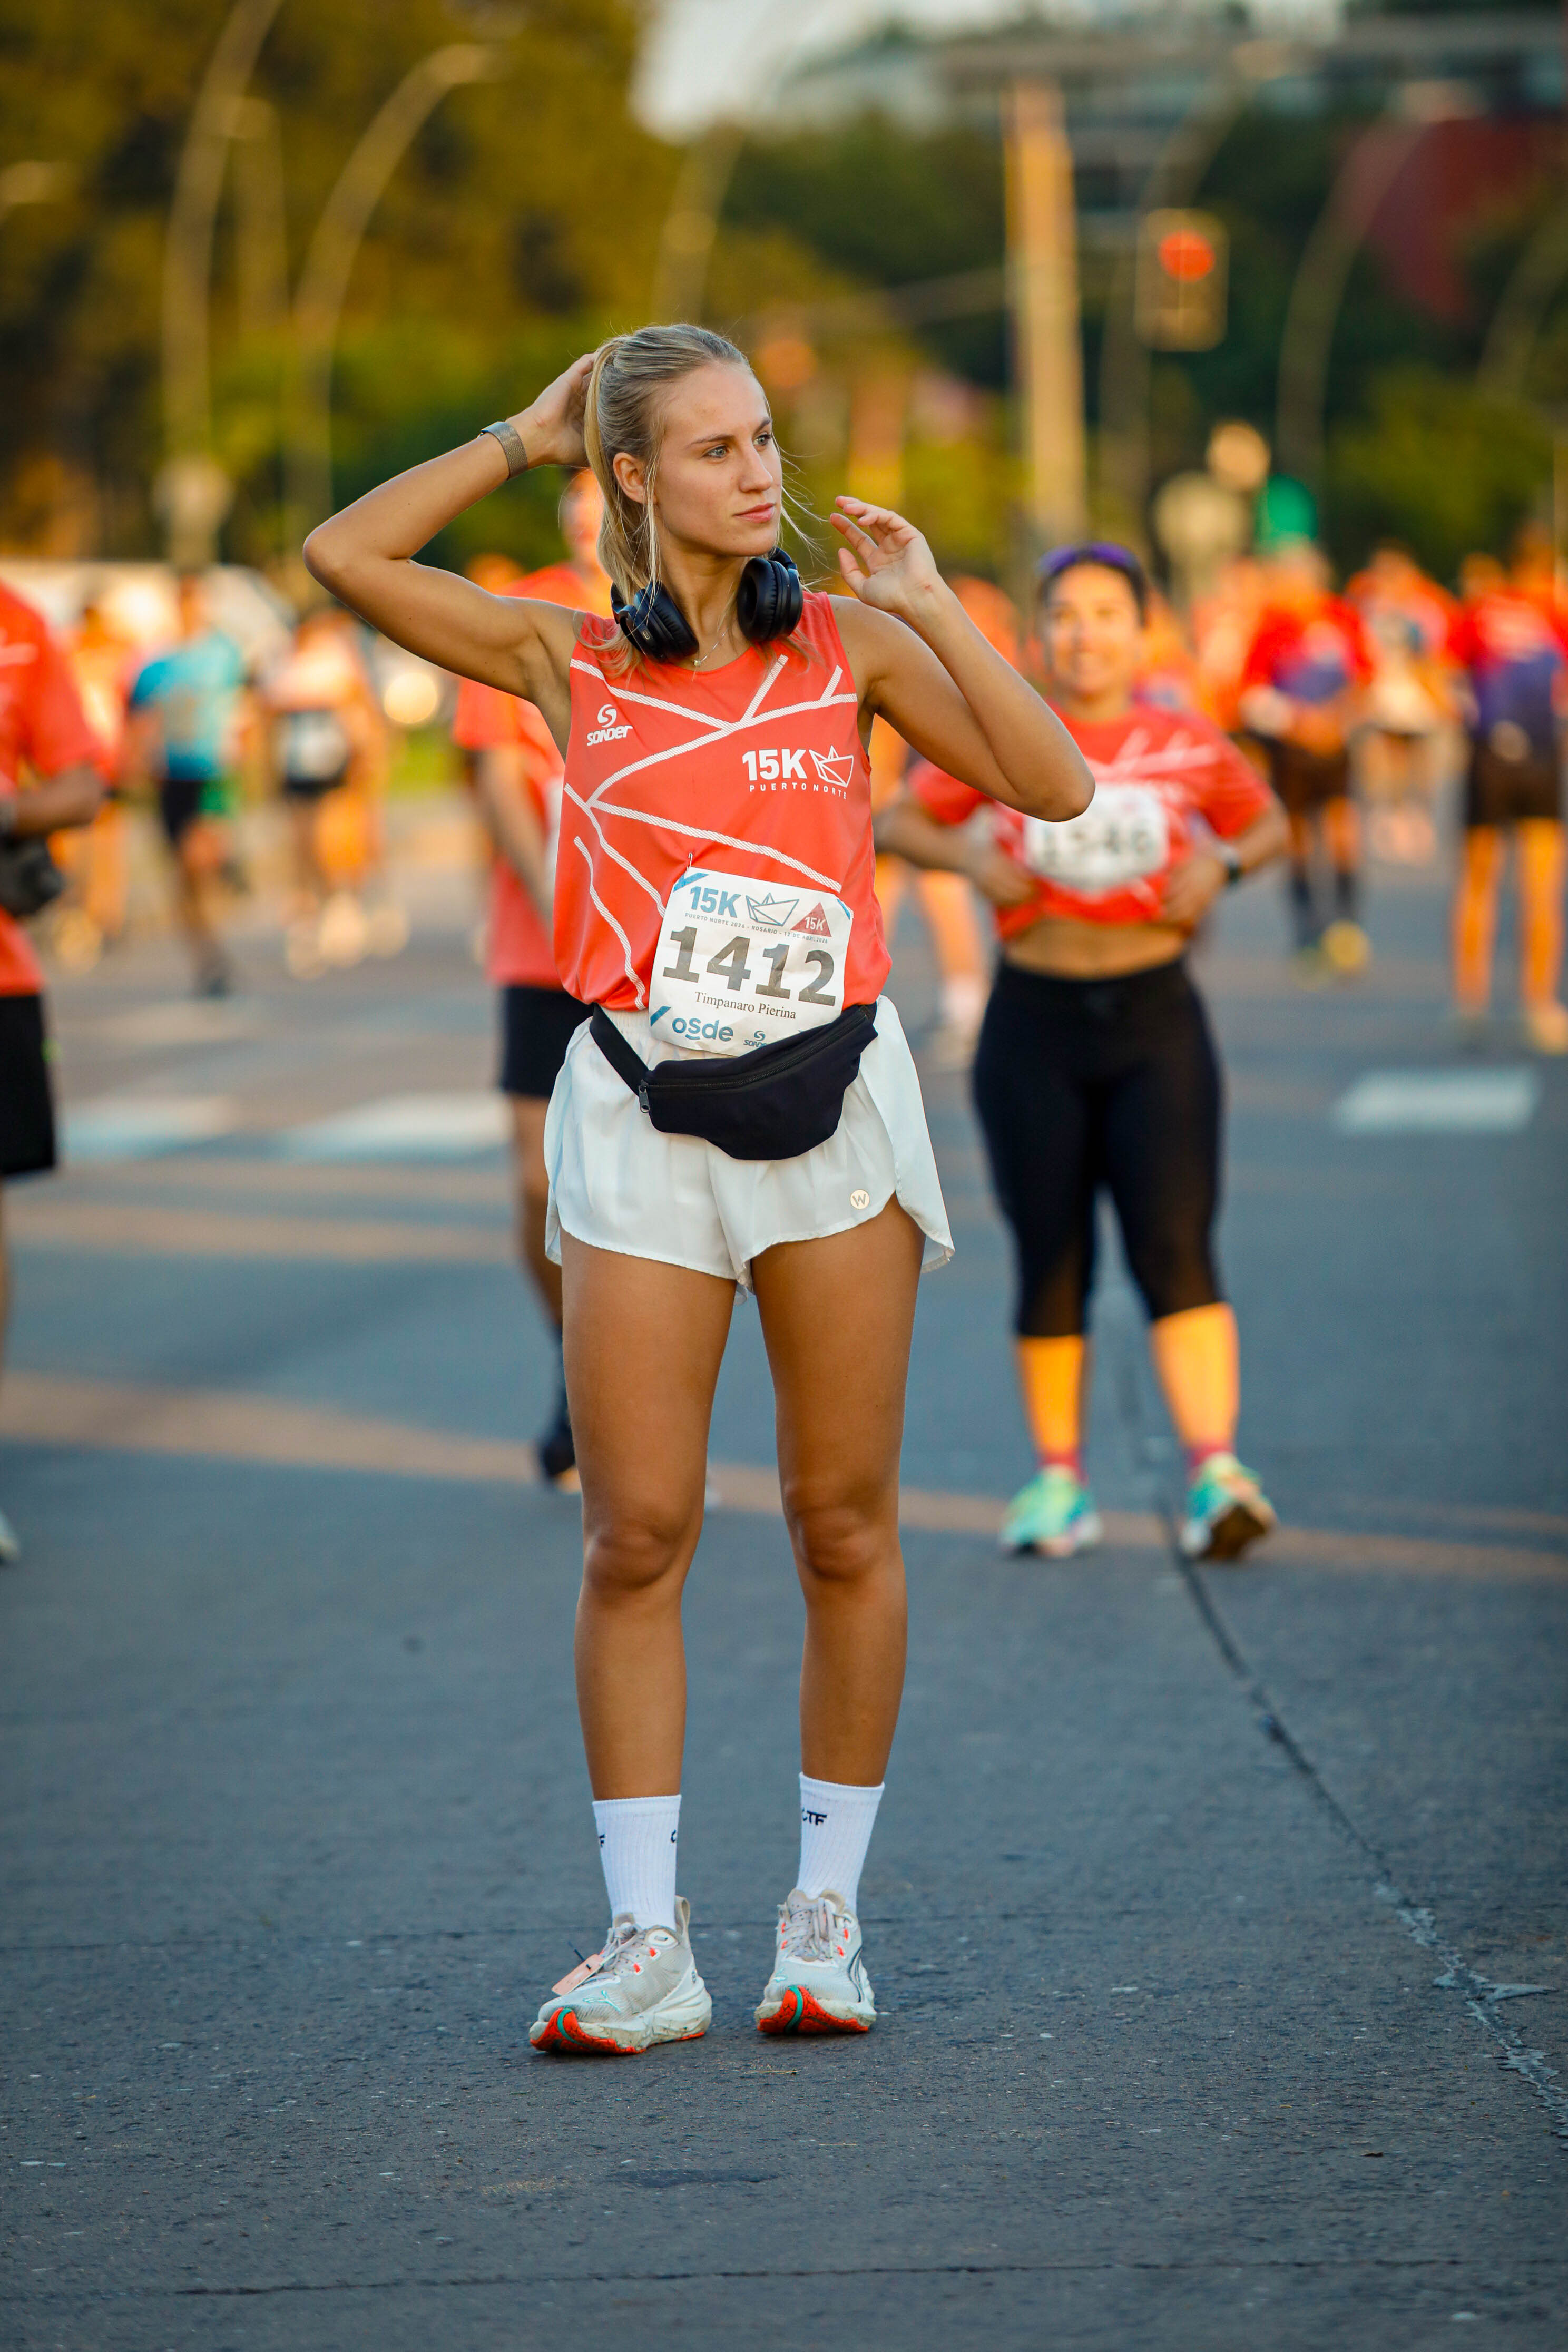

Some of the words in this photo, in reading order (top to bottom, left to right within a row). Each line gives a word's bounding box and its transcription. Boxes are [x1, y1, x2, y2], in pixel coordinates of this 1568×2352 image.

[742, 748, 807, 781] 15K
[749, 782, 807, 792] PUERTO
[813, 784, 846, 799] NORTE
[690, 886, 741, 918] 15K
[685, 913, 708, 921] PUERTO
[751, 925, 777, 935] ROSARIO
[805, 916, 826, 932] 15K
[662, 925, 837, 1007] 1412
[694, 991, 755, 1012] Timpanaro
[758, 1003, 797, 1020] Pierina
[672, 1017, 734, 1042] osde
[852, 1193, 867, 1206] W
